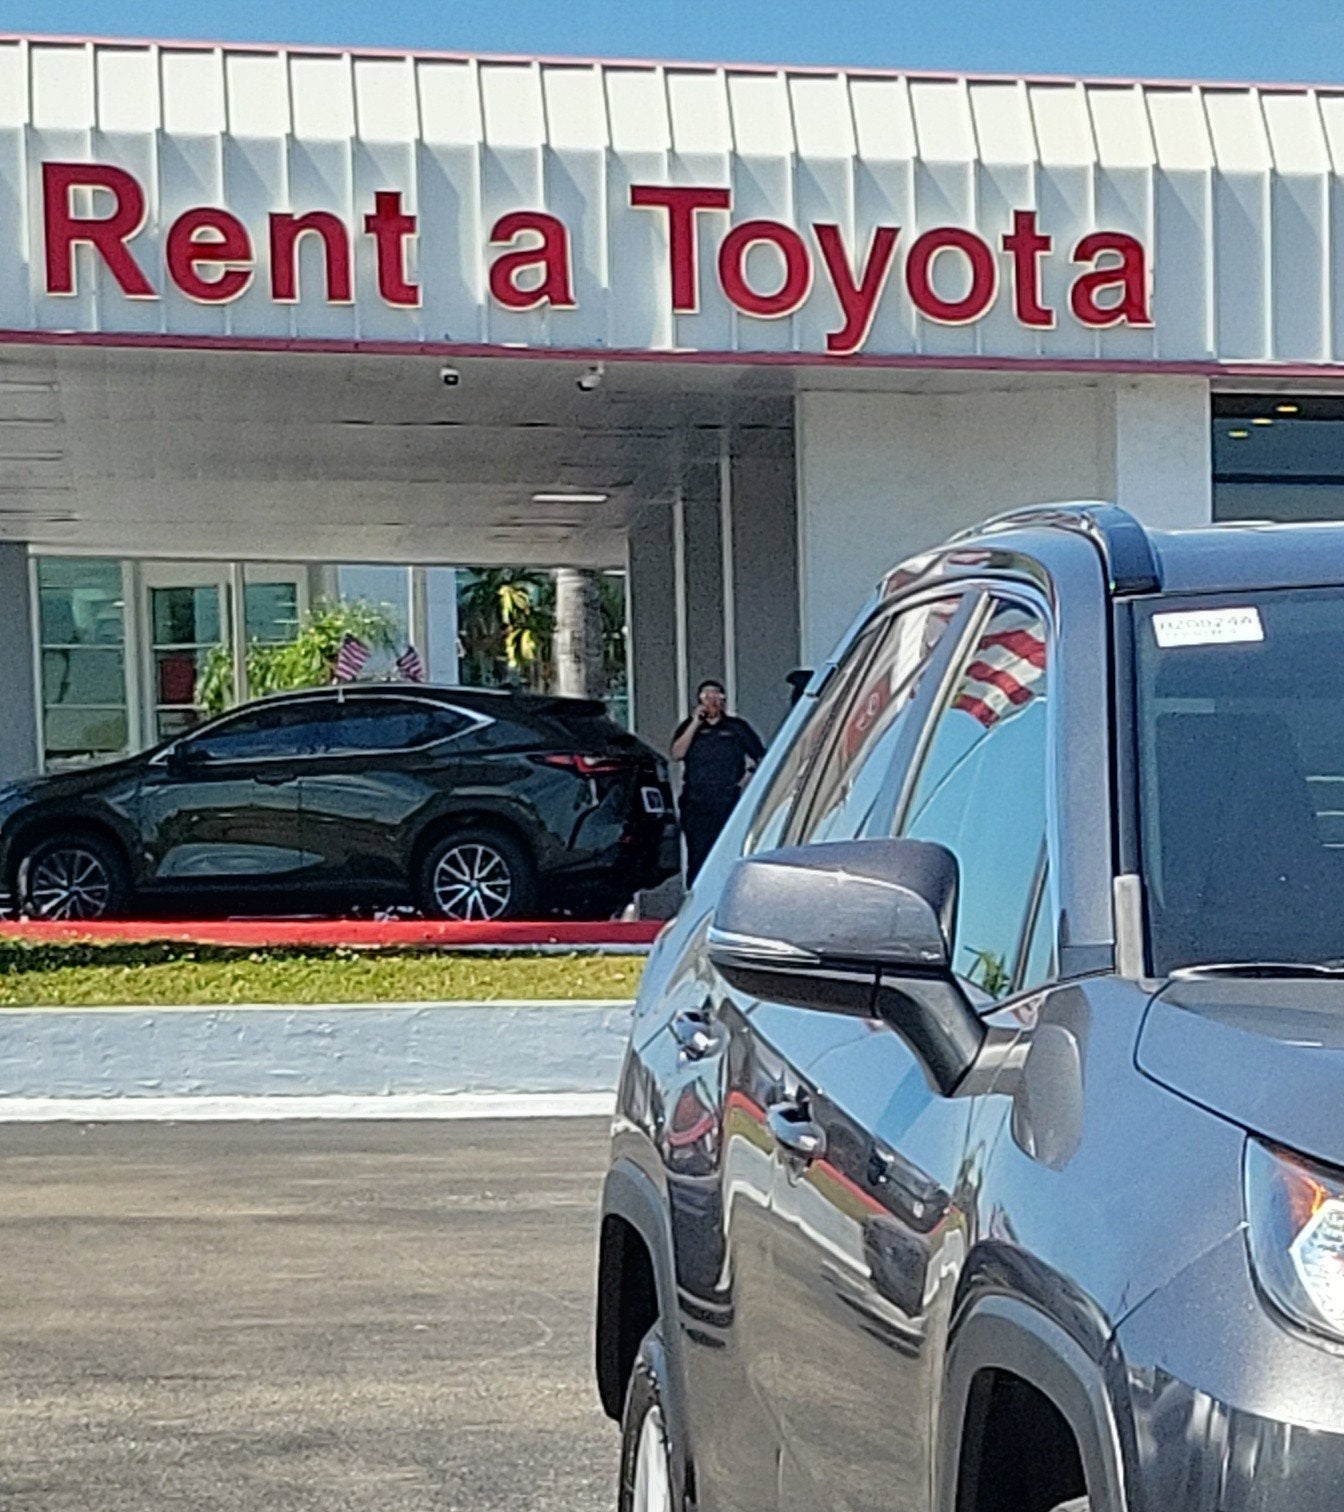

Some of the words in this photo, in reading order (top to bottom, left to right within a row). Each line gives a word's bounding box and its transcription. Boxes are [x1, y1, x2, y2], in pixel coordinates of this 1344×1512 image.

[41, 161, 421, 307] Rent
[488, 210, 576, 310] a
[630, 184, 1154, 354] Toyota
